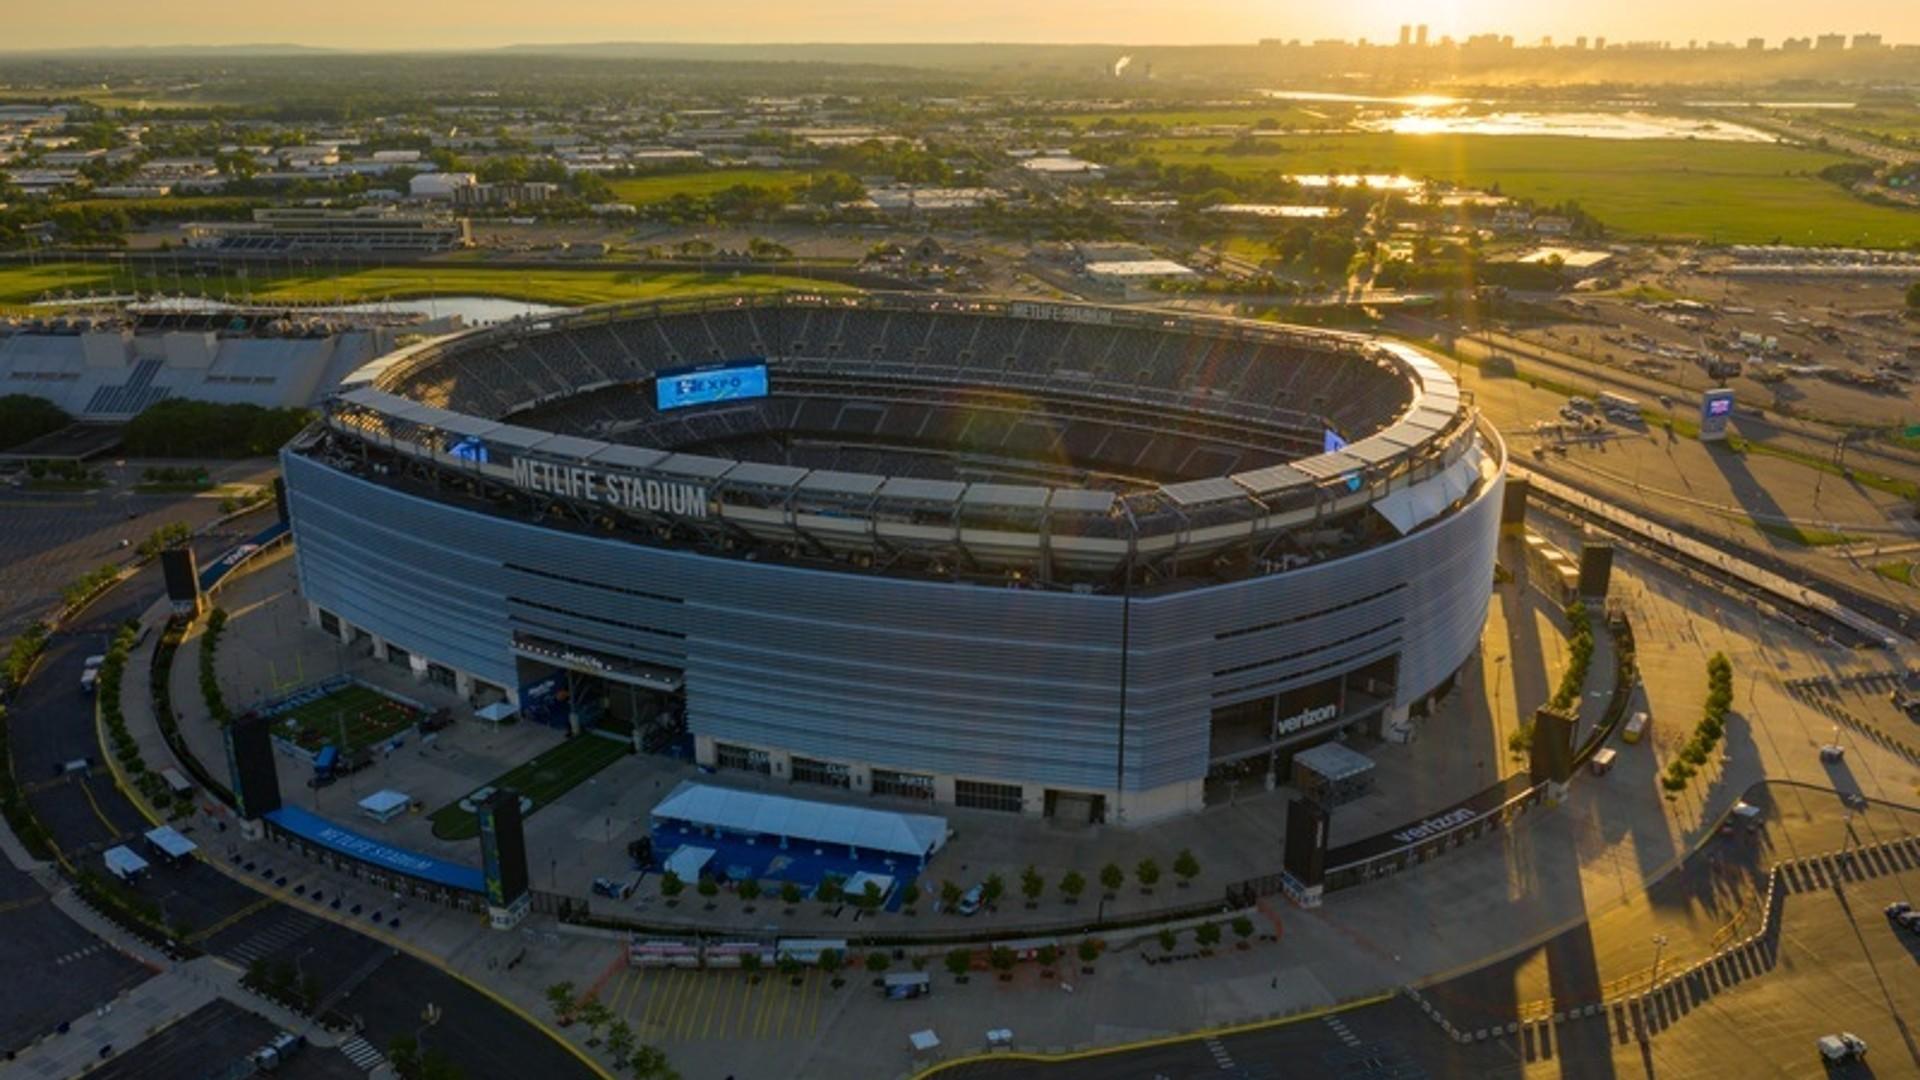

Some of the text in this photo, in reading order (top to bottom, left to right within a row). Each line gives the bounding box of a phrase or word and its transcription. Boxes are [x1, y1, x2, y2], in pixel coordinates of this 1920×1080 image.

[512, 456, 707, 518] METLIFE STADIUM
[1278, 704, 1337, 735] verizon
[1392, 807, 1477, 842] verizon
